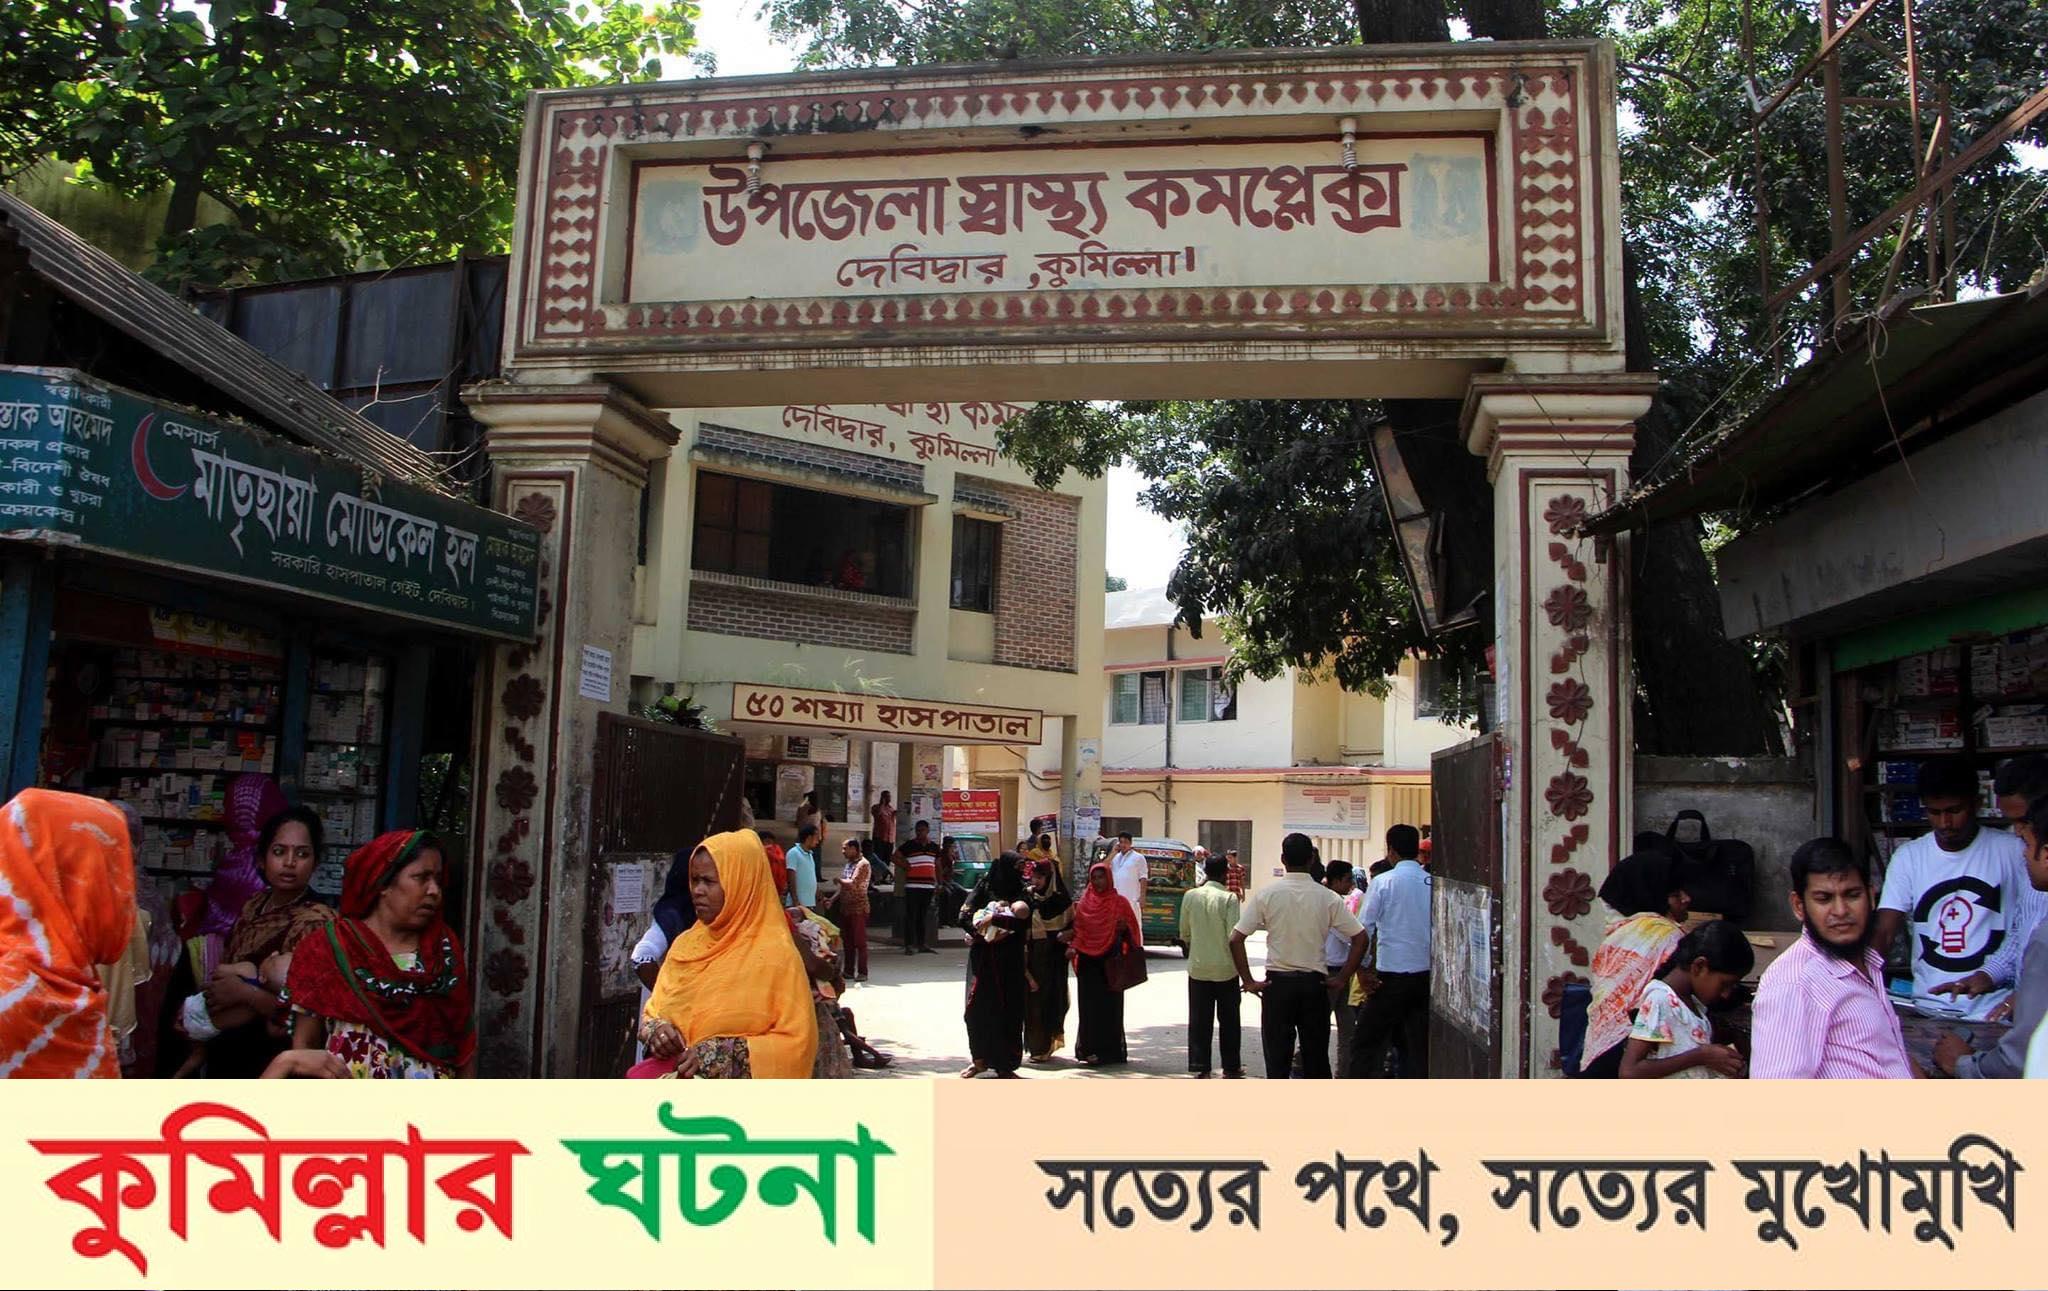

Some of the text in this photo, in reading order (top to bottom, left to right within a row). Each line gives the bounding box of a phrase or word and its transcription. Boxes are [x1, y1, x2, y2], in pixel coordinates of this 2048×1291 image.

[703, 164, 1408, 246] উপজেলা স্বাস্থ্য কমপ্লেক্স
[837, 243, 1007, 288] দেবিদ্বার
[48, 403, 115, 446] আহমেদ
[163, 421, 221, 449] মেসার্স
[907, 430, 998, 467] কুমিল্লা
[48, 485, 64, 496] ও
[191, 447, 319, 559] মাতৃছায়া
[444, 524, 480, 591] হল
[271, 551, 321, 575] সরকারি
[326, 563, 386, 592] হাসপাতাল
[746, 692, 1031, 737] ৫০ শয্যা হাসপাতাল
